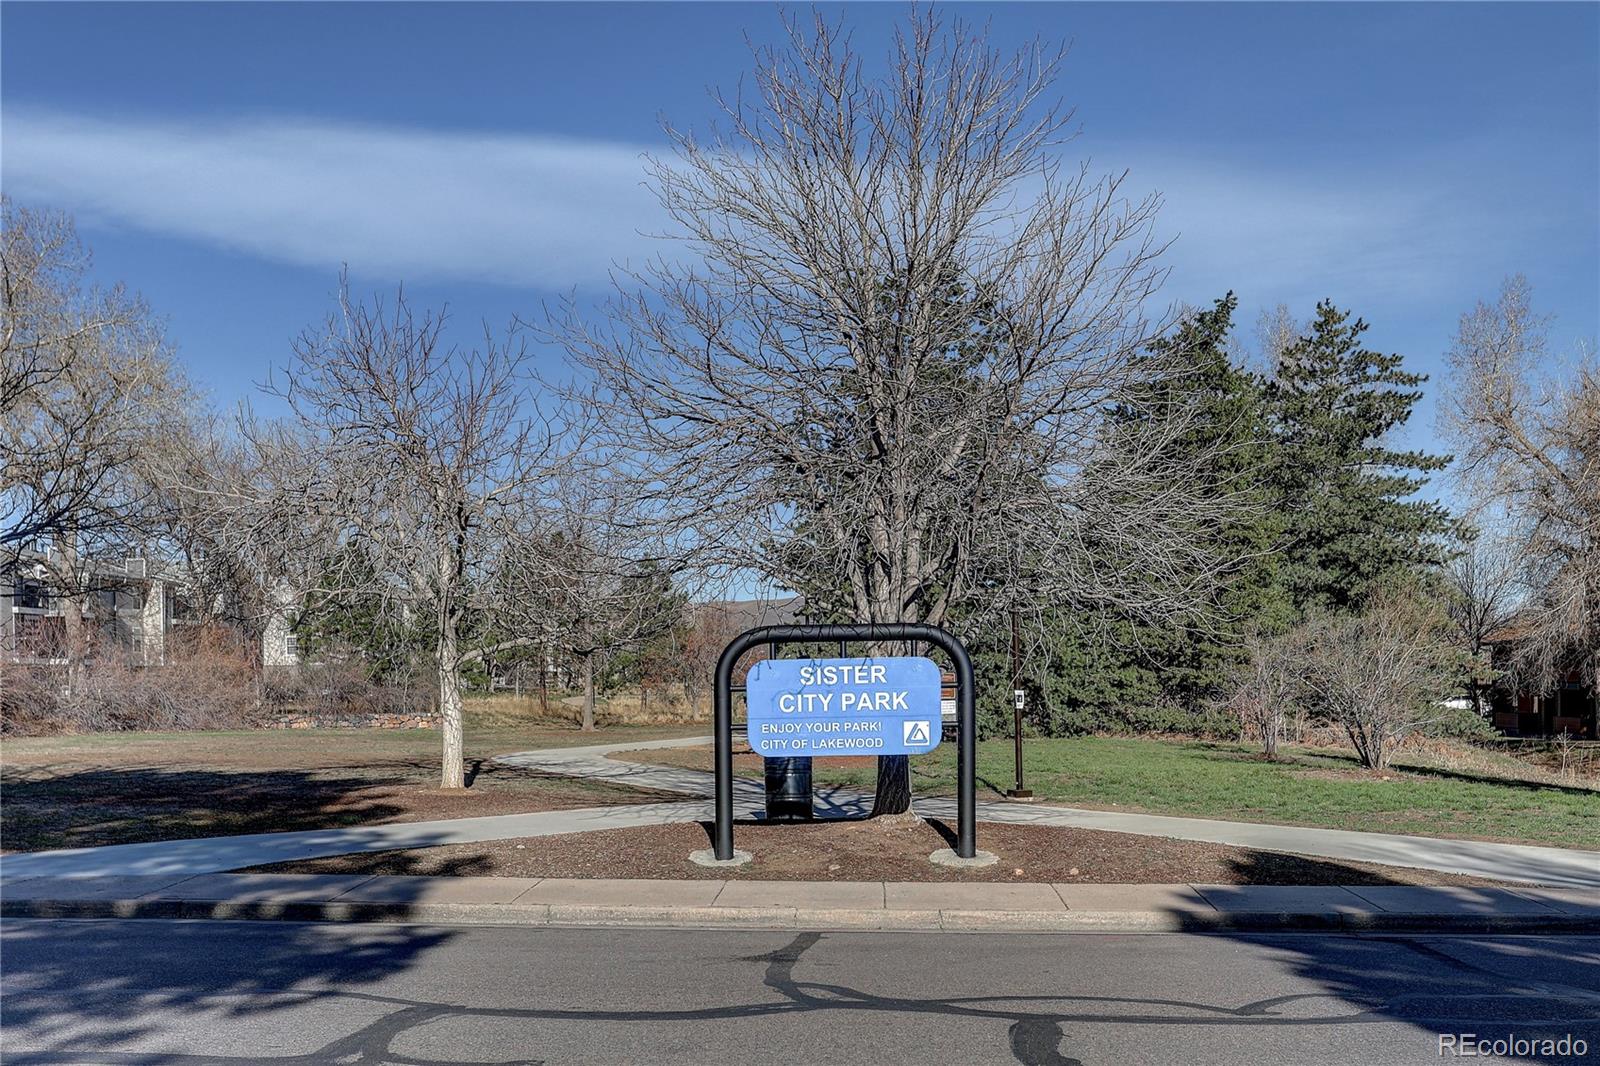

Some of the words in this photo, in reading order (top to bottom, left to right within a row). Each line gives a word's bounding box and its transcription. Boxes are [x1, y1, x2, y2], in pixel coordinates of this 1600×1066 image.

[799, 665, 887, 686] SISTER
[779, 693, 834, 713] CITY
[841, 691, 909, 711] PARK
[761, 722, 802, 733] ENJOY
[805, 722, 840, 733] YOUR
[844, 721, 882, 732] PARK!
[761, 739, 787, 750] CITY
[791, 739, 808, 749] OF
[812, 737, 884, 749] LAKEWOOD
